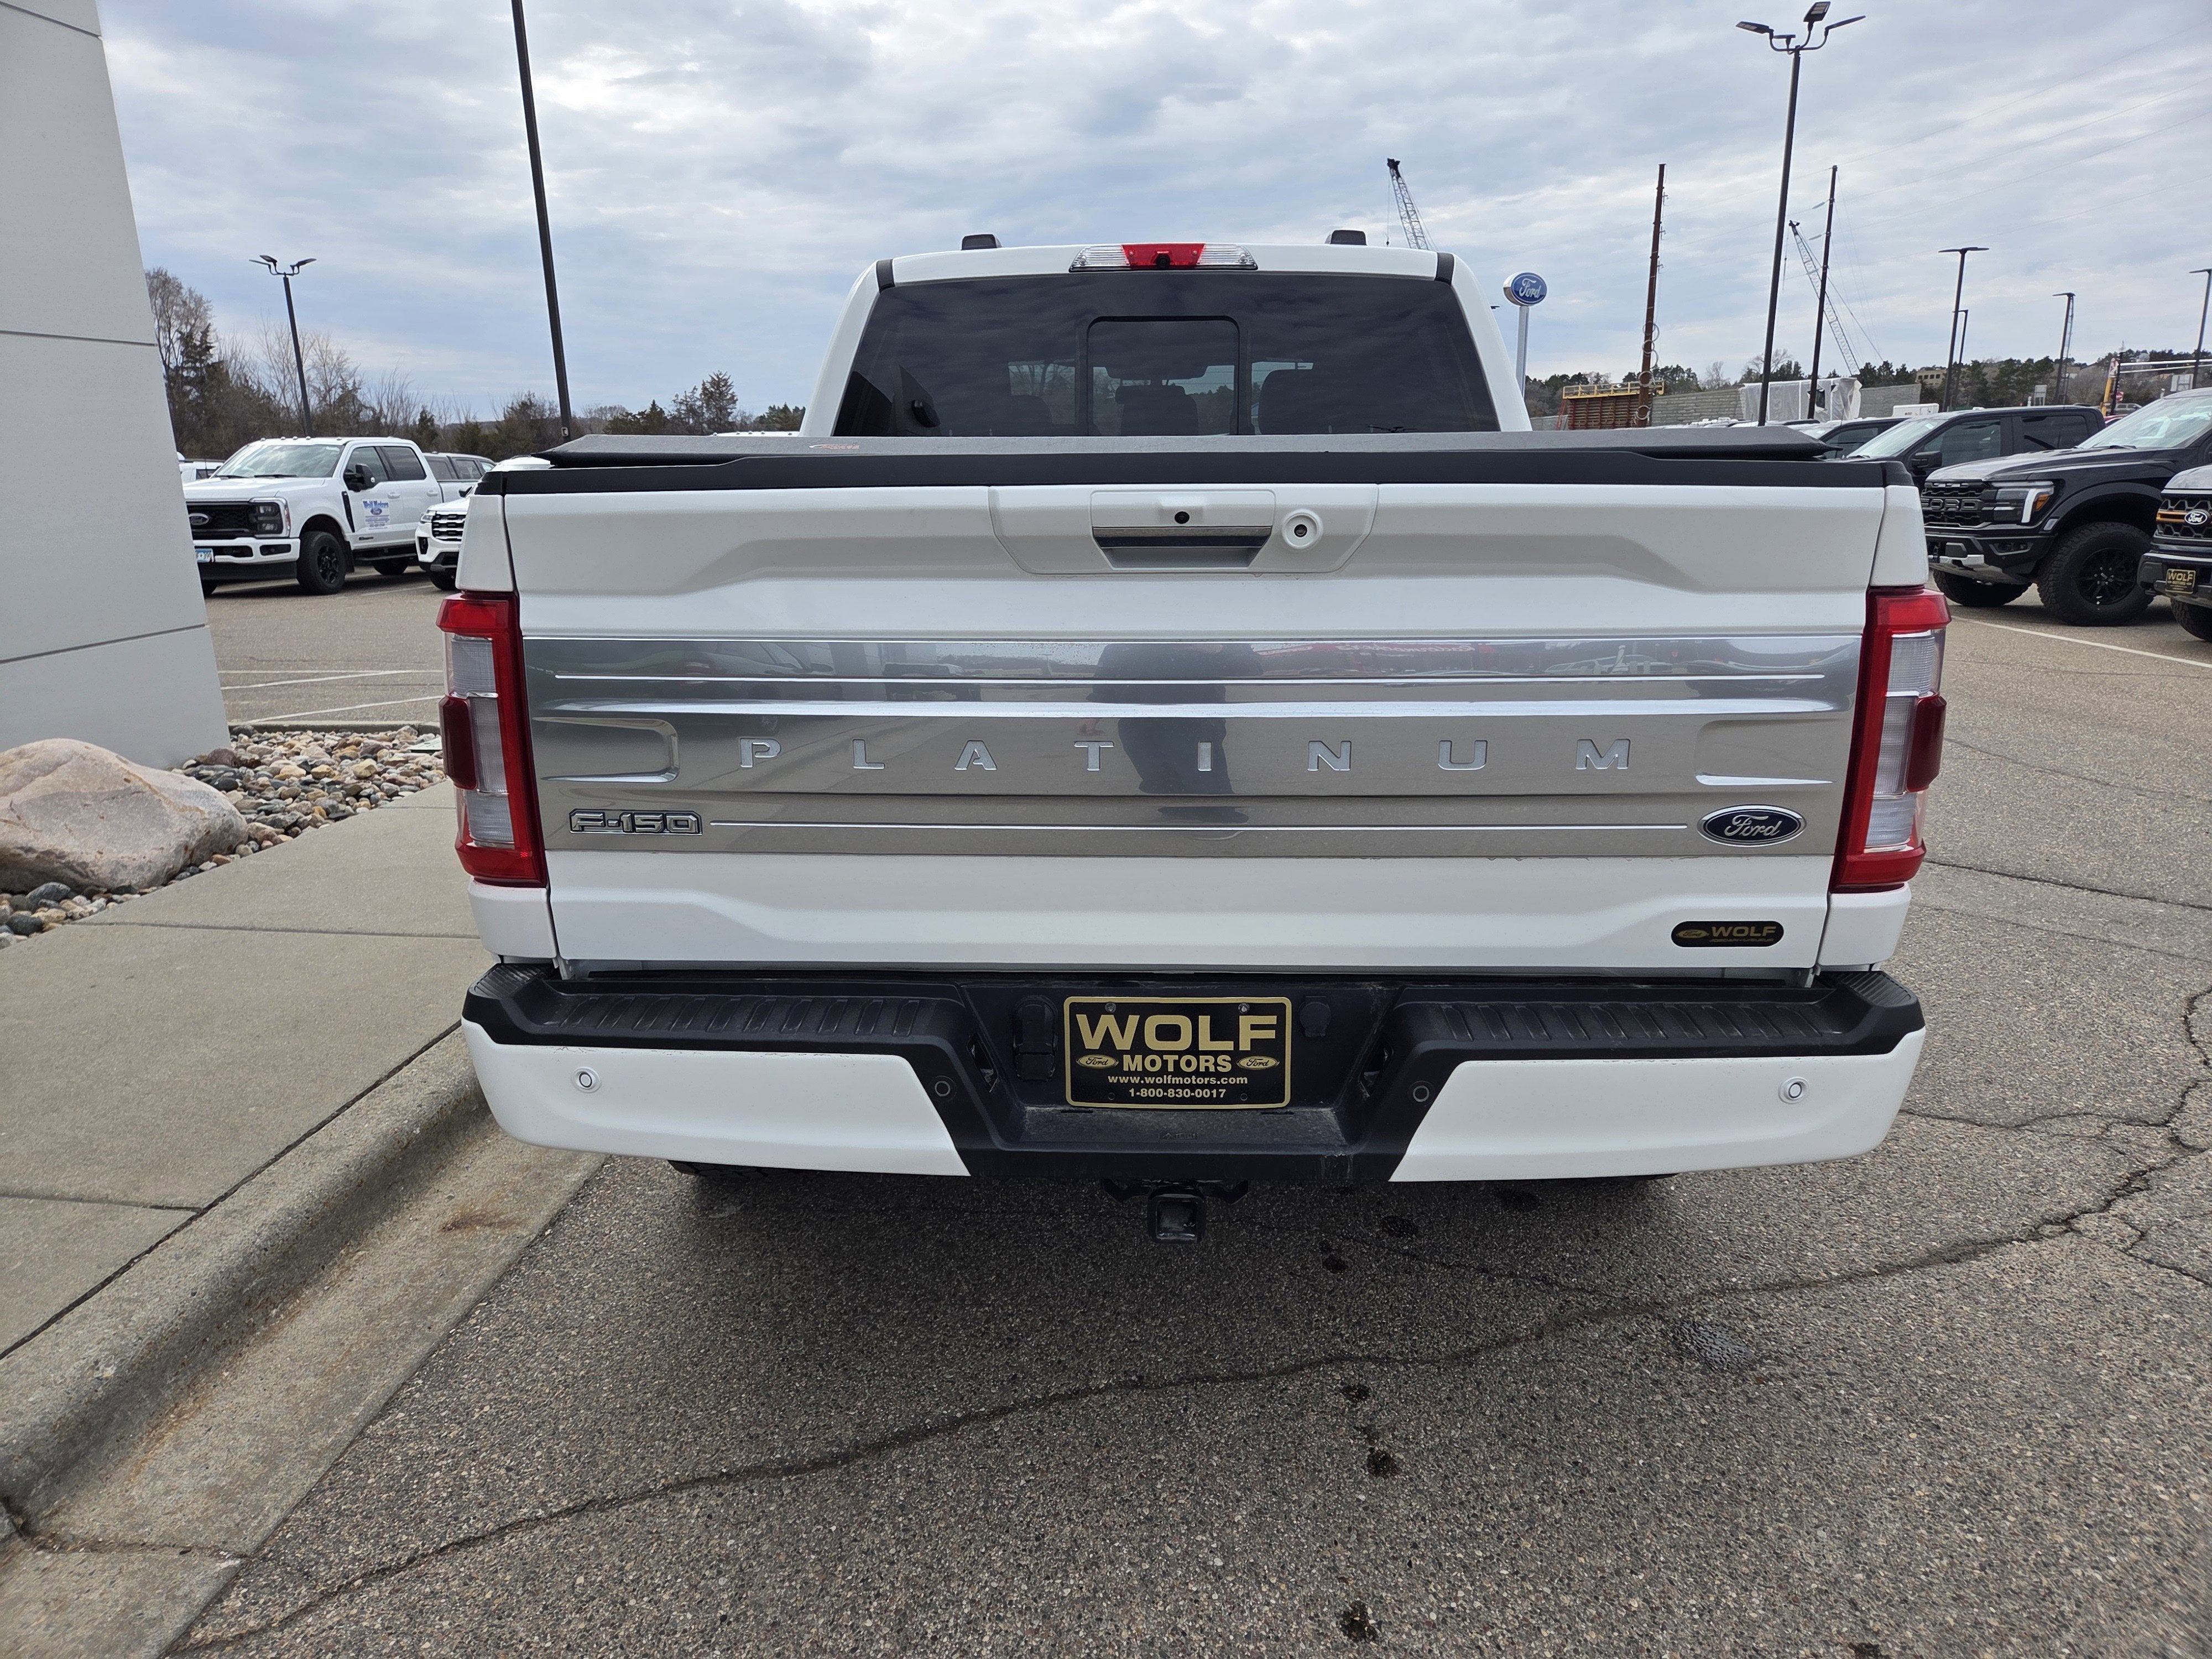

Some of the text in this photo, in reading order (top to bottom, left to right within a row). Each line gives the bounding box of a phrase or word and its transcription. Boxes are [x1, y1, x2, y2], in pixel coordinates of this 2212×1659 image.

[1519, 278, 1541, 298] Ford
[2188, 513, 2203, 522] Ford
[2168, 572, 2193, 582] WOLF
[739, 738, 1630, 771] PLATINUM
[570, 811, 701, 834] F-150
[1724, 815, 1782, 836] Ford
[1712, 926, 1776, 937] WOLF
[1076, 1014, 1277, 1051] WOLF
[1086, 1055, 1270, 1072] Ford MOTORS Ford
[1108, 1074, 1248, 1085] www.wolfmotors.com
[1129, 1088, 1227, 1098] 1-800-830-0017
